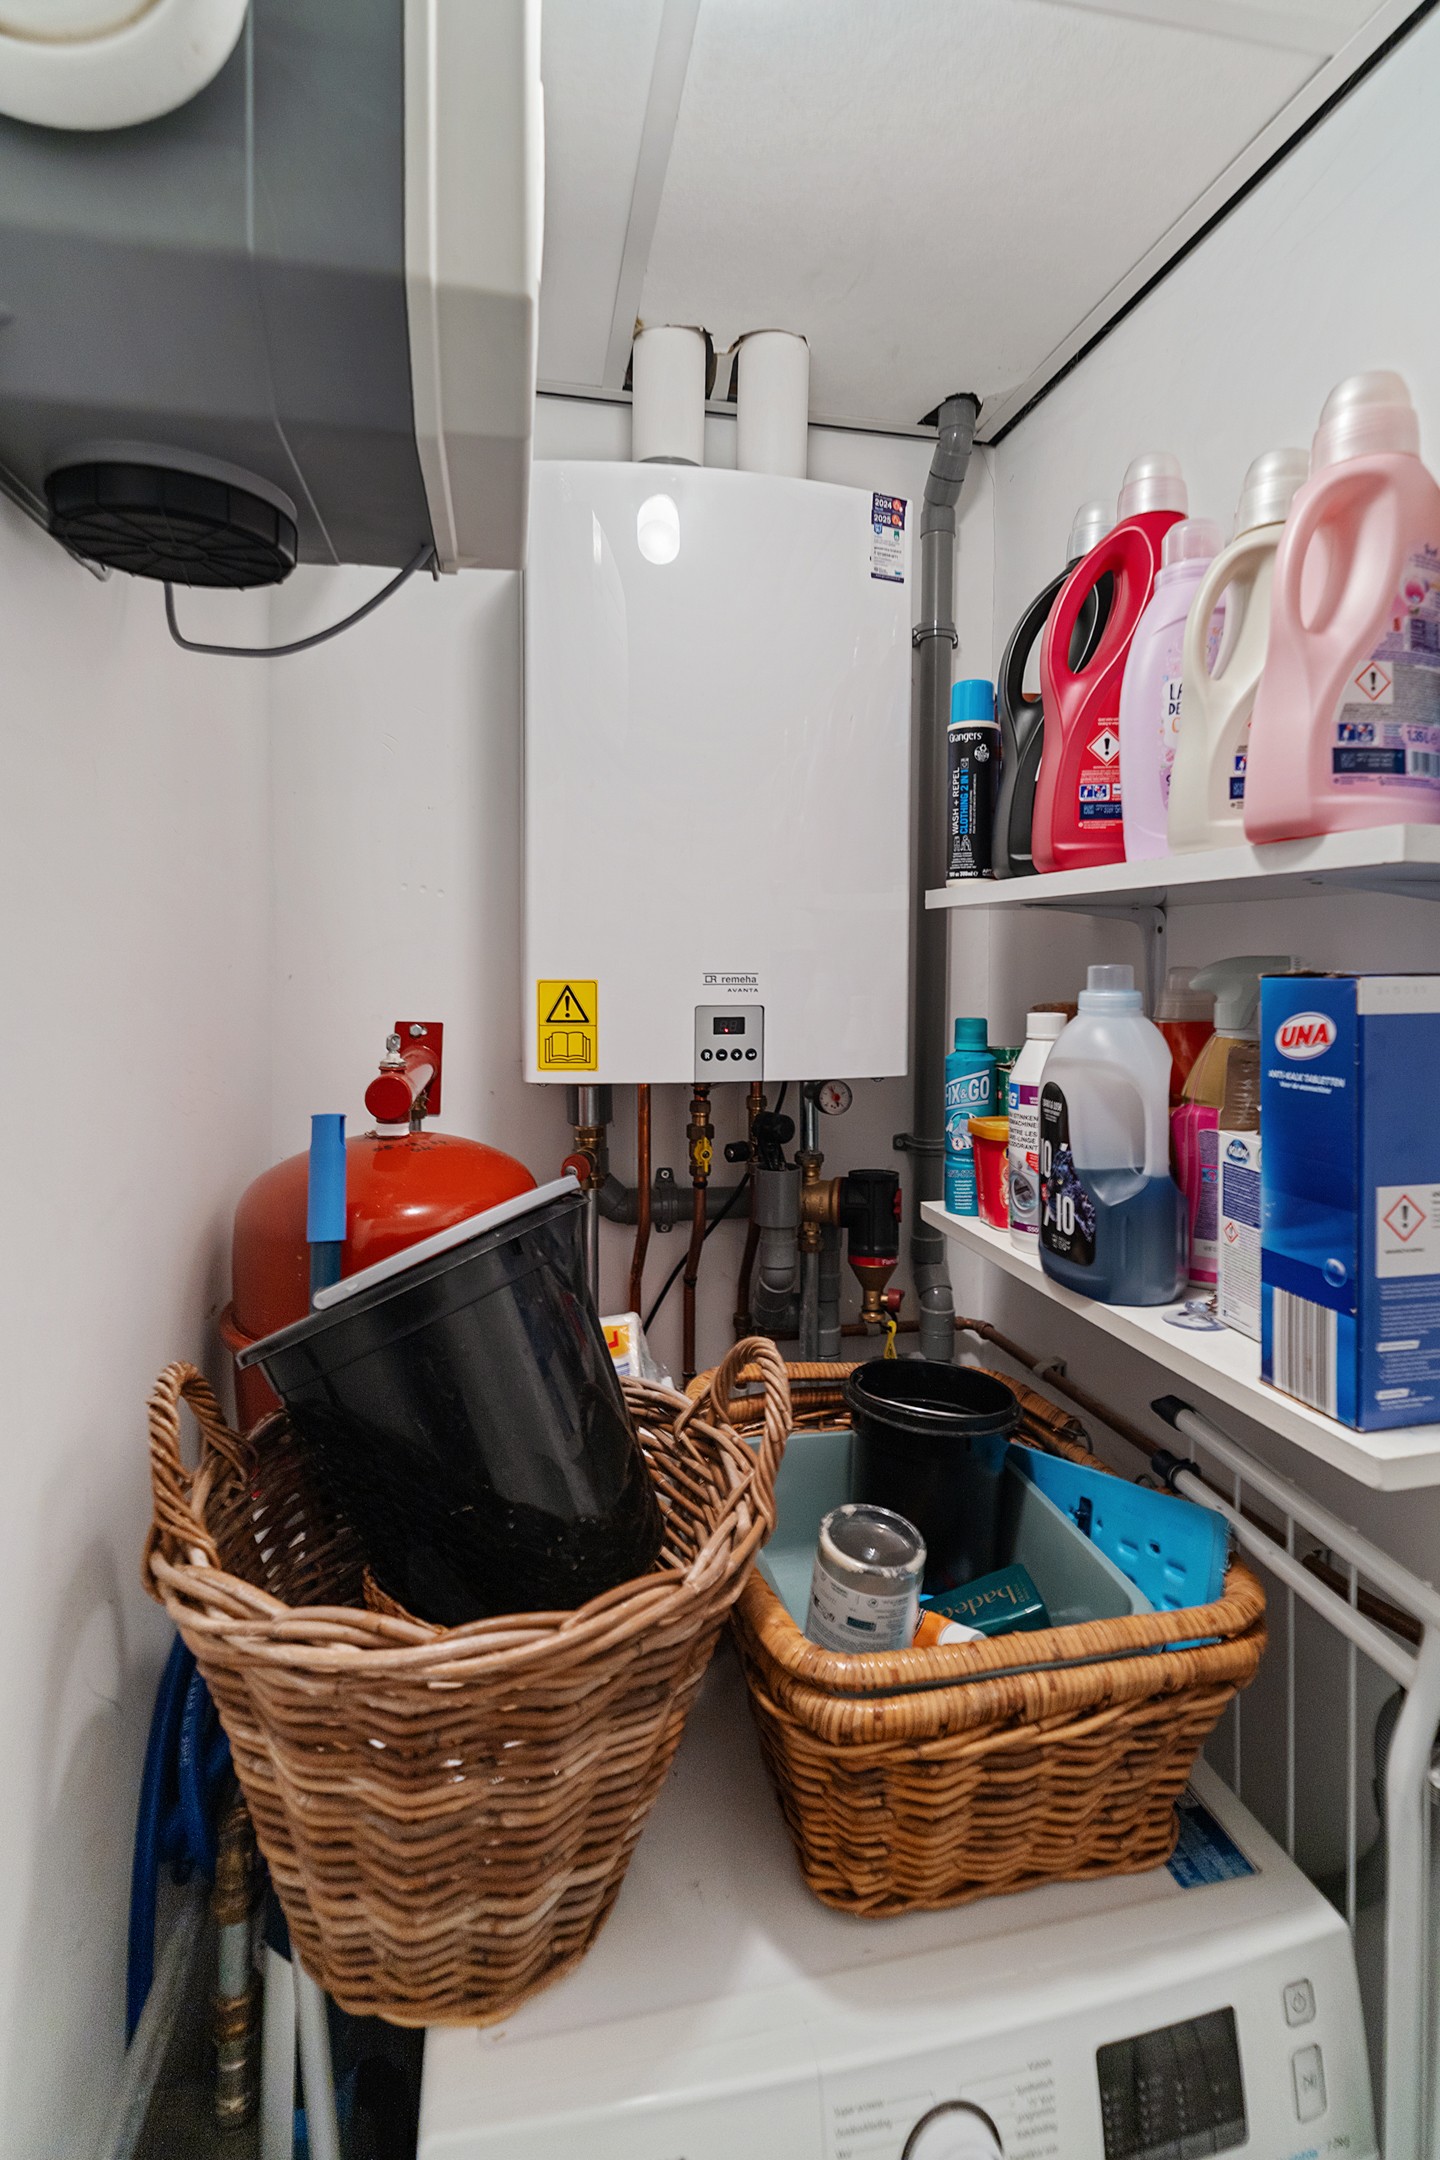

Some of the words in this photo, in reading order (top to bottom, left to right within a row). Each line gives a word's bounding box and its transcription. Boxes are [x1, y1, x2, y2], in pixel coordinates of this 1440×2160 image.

[874, 497, 892, 509] 2024
[873, 513, 891, 525] 2025
[949, 732, 982, 743] Grangers
[960, 793, 969, 834] CLOTHING
[721, 975, 757, 984] remeha
[1281, 1023, 1330, 1048] UNA
